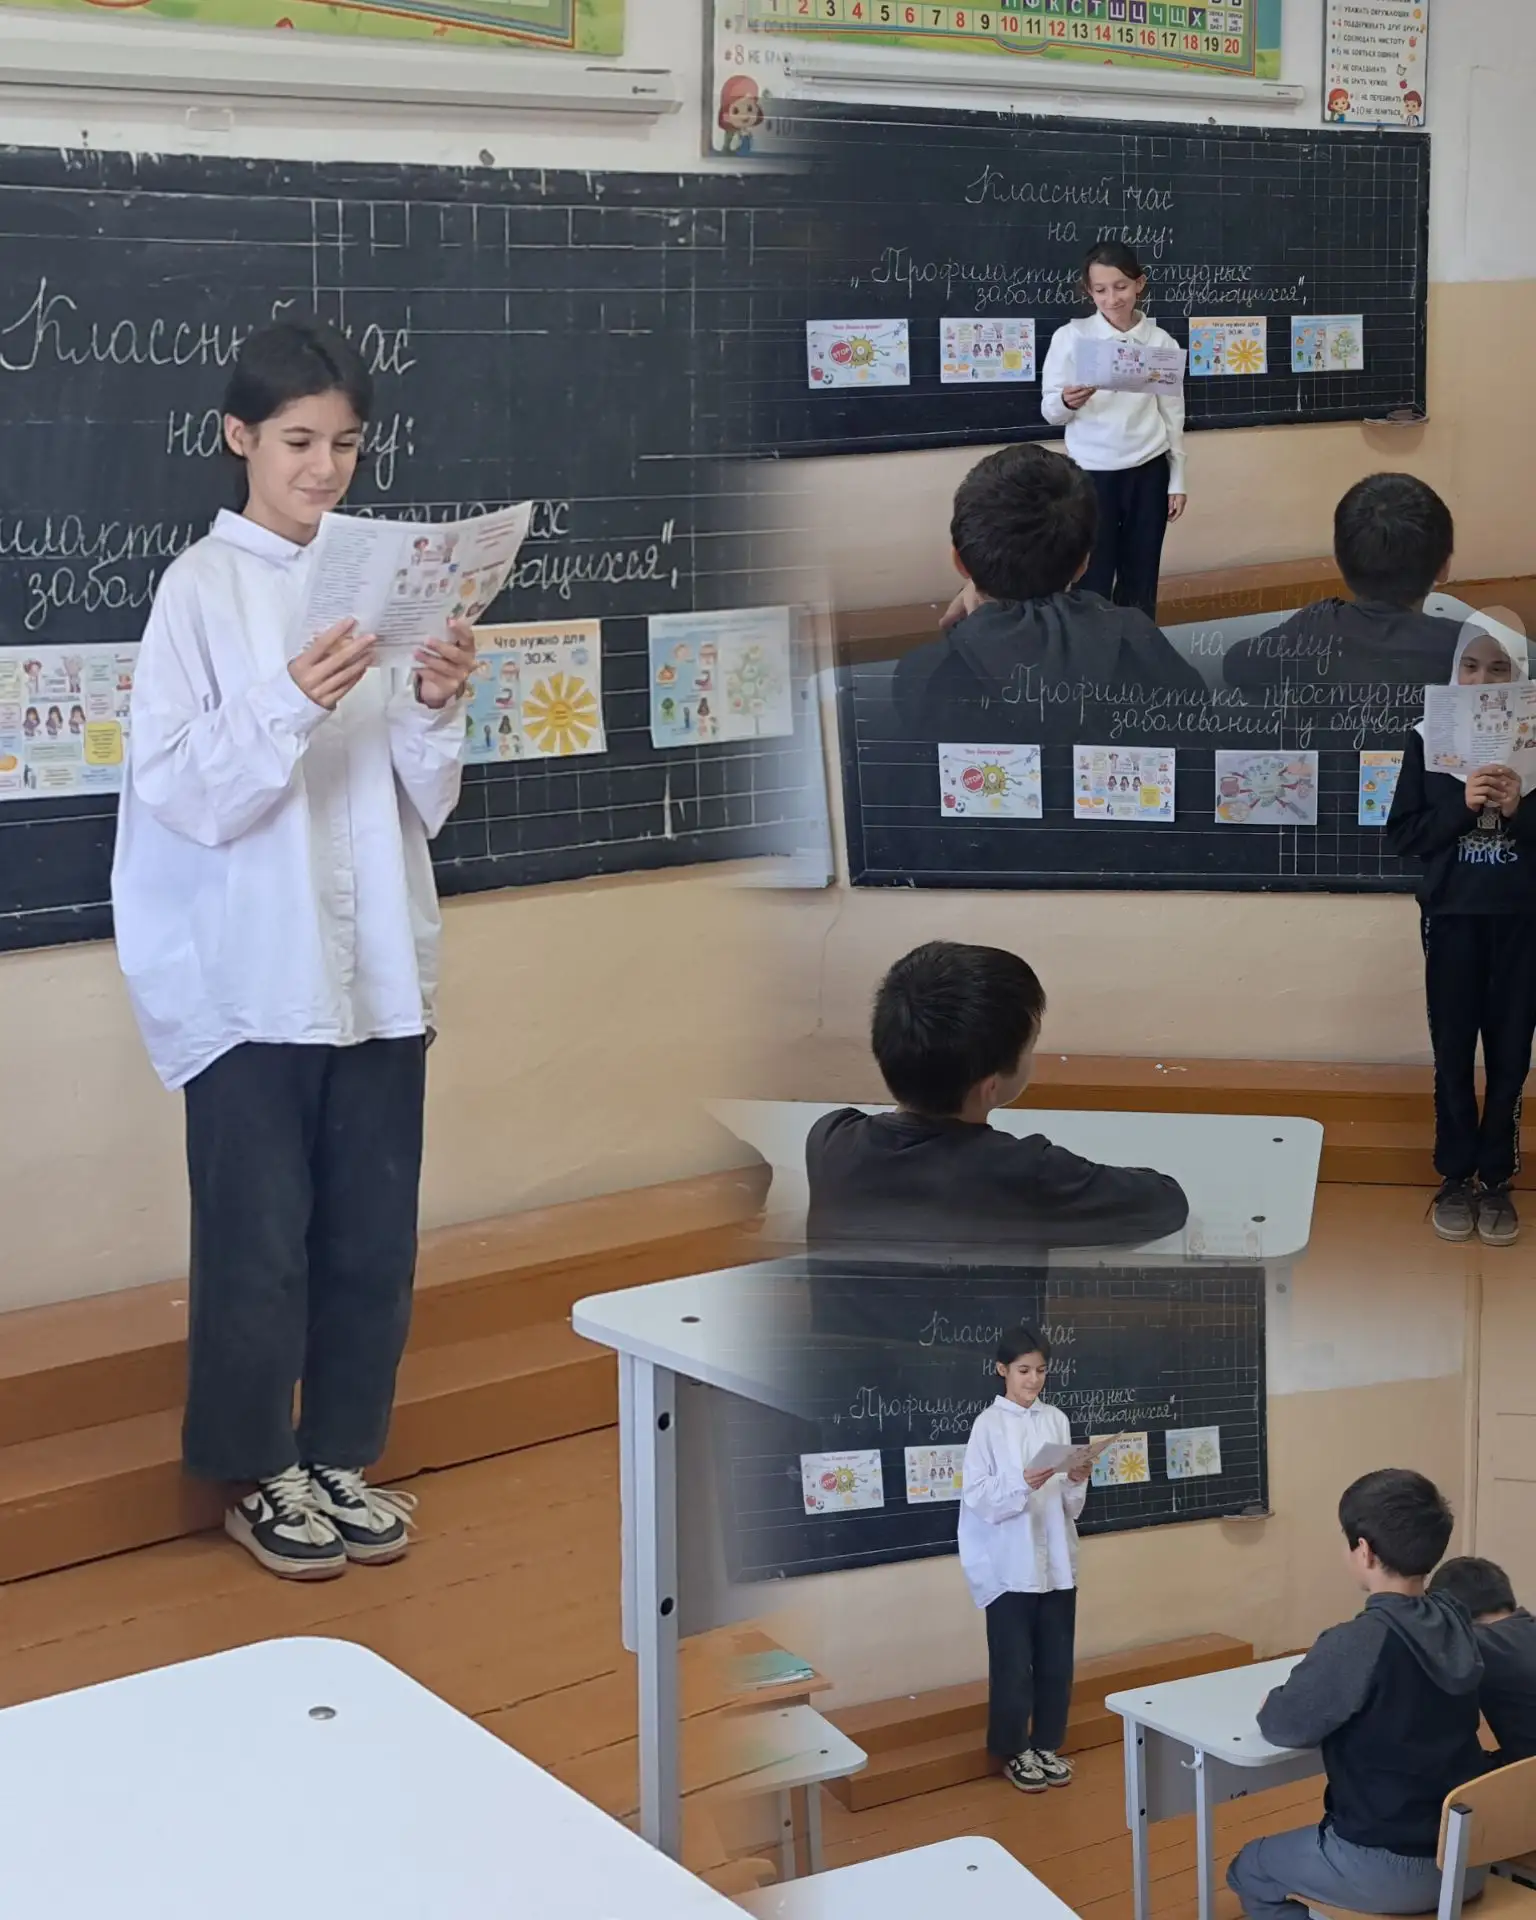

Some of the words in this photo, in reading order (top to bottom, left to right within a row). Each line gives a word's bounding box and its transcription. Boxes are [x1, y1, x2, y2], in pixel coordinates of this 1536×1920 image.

[798, 0, 809, 14] 2
[825, 0, 836, 17] 3
[851, 2, 863, 19] 4
[880, 4, 890, 22] 5
[904, 6, 915, 24] 6
[931, 9, 942, 26] 7
[955, 11, 965, 28] 8
[980, 13, 991, 30] 9
[1000, 15, 1019, 33] 10
[1026, 17, 1041, 35] 11
[1048, 20, 1066, 37] 12
[1071, 22, 1089, 39] 13
[1094, 24, 1112, 42] 14
[1117, 26, 1134, 44] 15
[1139, 29, 1156, 46] 16
[1161, 31, 1177, 48] 17
[1183, 34, 1199, 50] 18
[1204, 36, 1219, 52] 19
[1224, 38, 1240, 54] 20
[1071, 0, 1082, 13] С
[1091, 0, 1102, 16] Т
[1109, 2, 1125, 19] Ш
[1132, 4, 1145, 23] Ц
[1152, 6, 1163, 23] Ч
[1170, 8, 1186, 27] Щ
[1191, 11, 1202, 29] Х
[965, 164, 1113, 206] Классный
[1125, 185, 1174, 210] час
[1048, 220, 1080, 242] на
[494, 636, 517, 649] Что
[520, 635, 560, 650] нужно
[563, 633, 586, 645] для
[1190, 630, 1227, 656] на
[1110, 703, 1283, 739] заболеваний
[1299, 715, 1313, 749] у
